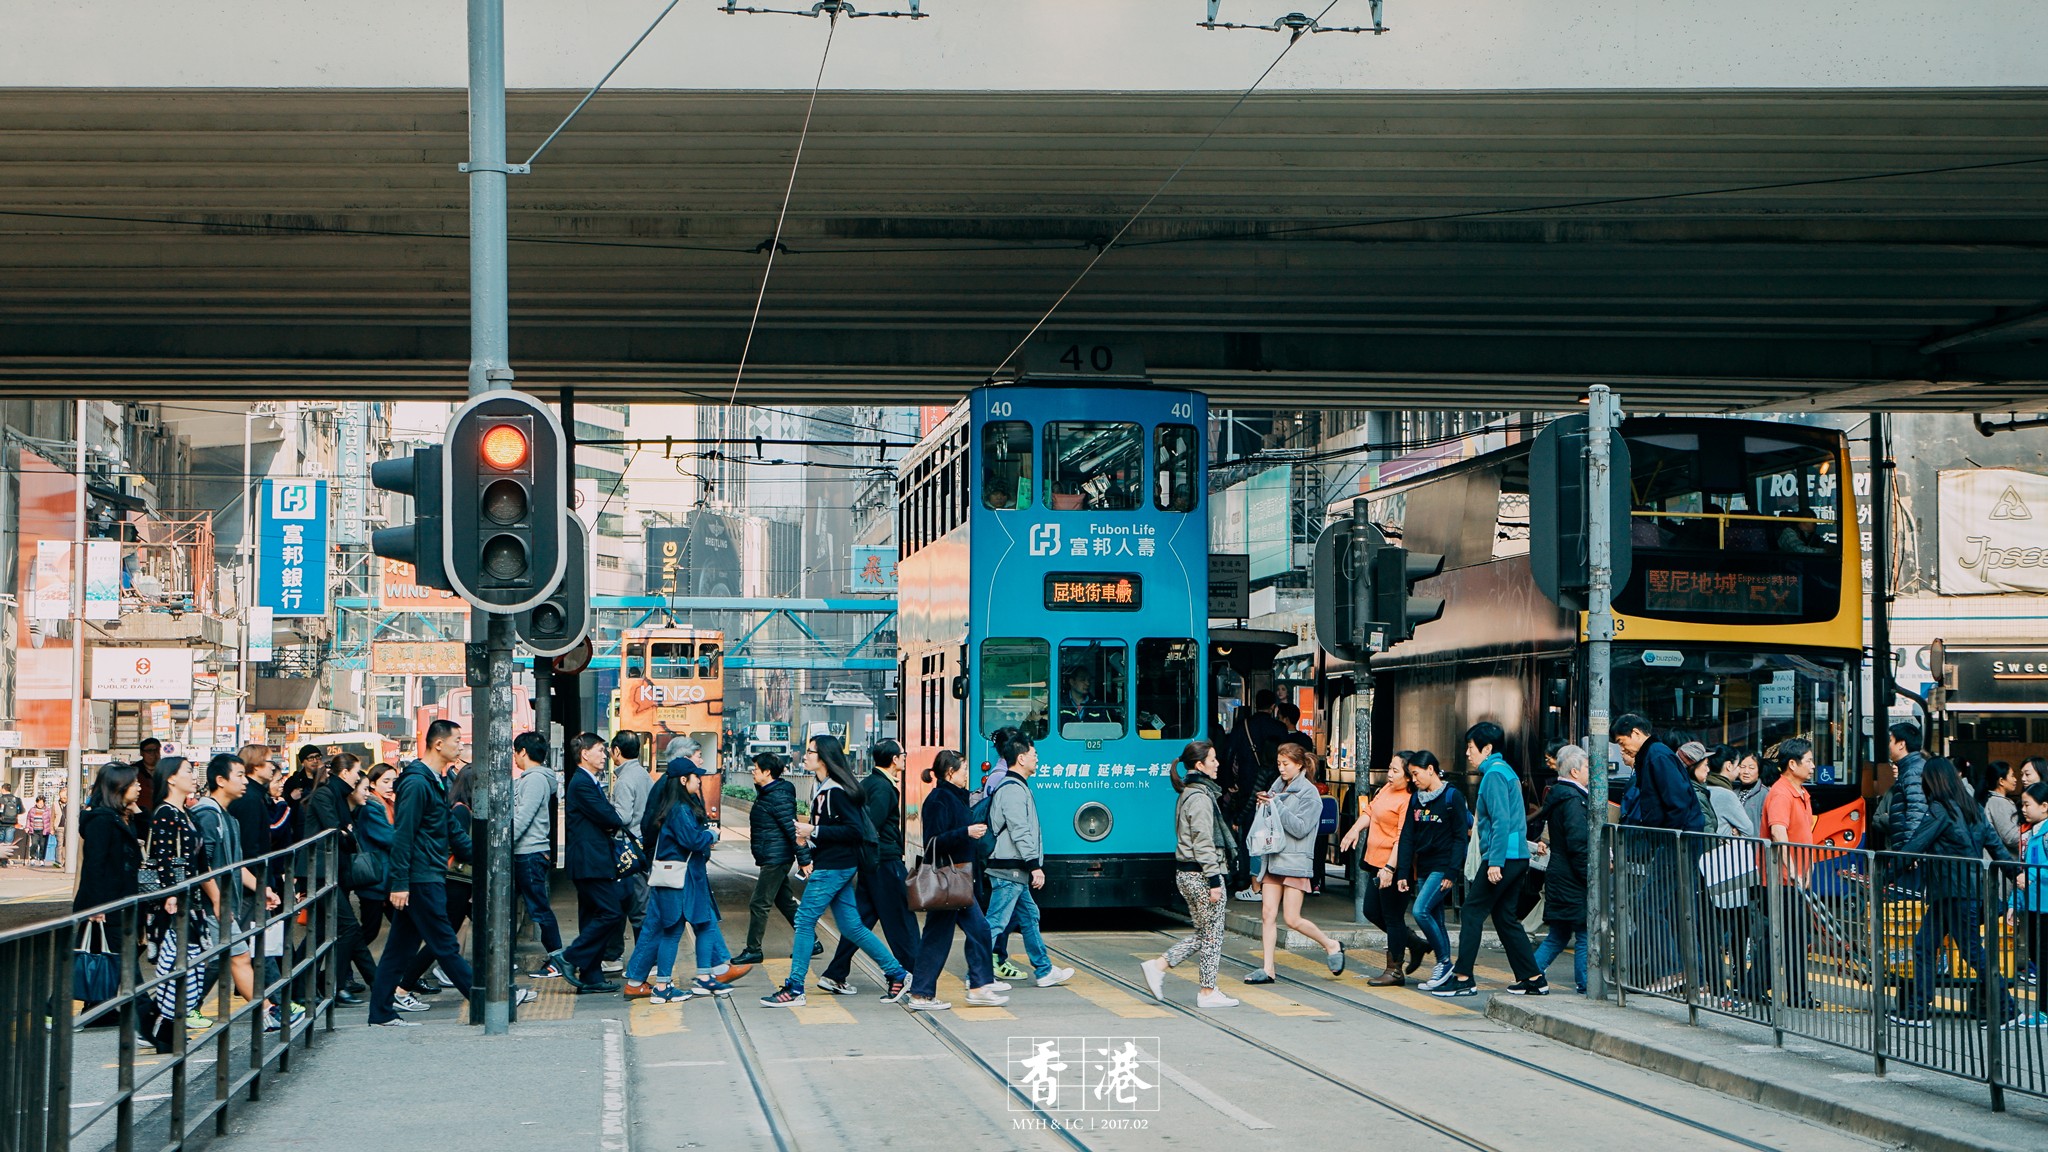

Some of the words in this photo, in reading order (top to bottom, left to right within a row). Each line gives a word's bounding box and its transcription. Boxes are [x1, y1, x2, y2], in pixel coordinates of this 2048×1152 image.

[1059, 344, 1113, 372] 40
[990, 401, 1012, 418] 40
[1171, 402, 1191, 419] 40
[1770, 473, 1816, 497] ROE
[1090, 523, 1129, 535] Fubon
[1133, 524, 1155, 535] Life
[705, 536, 728, 549] BREITLING
[1070, 537, 1155, 557] 富邦人壽
[281, 524, 304, 609] 富邦銀行
[1649, 570, 1737, 594] 堅尼地城
[1737, 573, 1771, 585] Express
[385, 583, 430, 599] WING
[1053, 582, 1133, 603] 屈地街車廠
[1750, 585, 1790, 613] 5X
[640, 685, 706, 702] KENZO
[1086, 740, 1102, 750] 025
[1030, 763, 1091, 777] 生命價值
[1097, 763, 1172, 777] 延伸每一希望
[1036, 780, 1150, 790] www.fubonlife.com.hk
